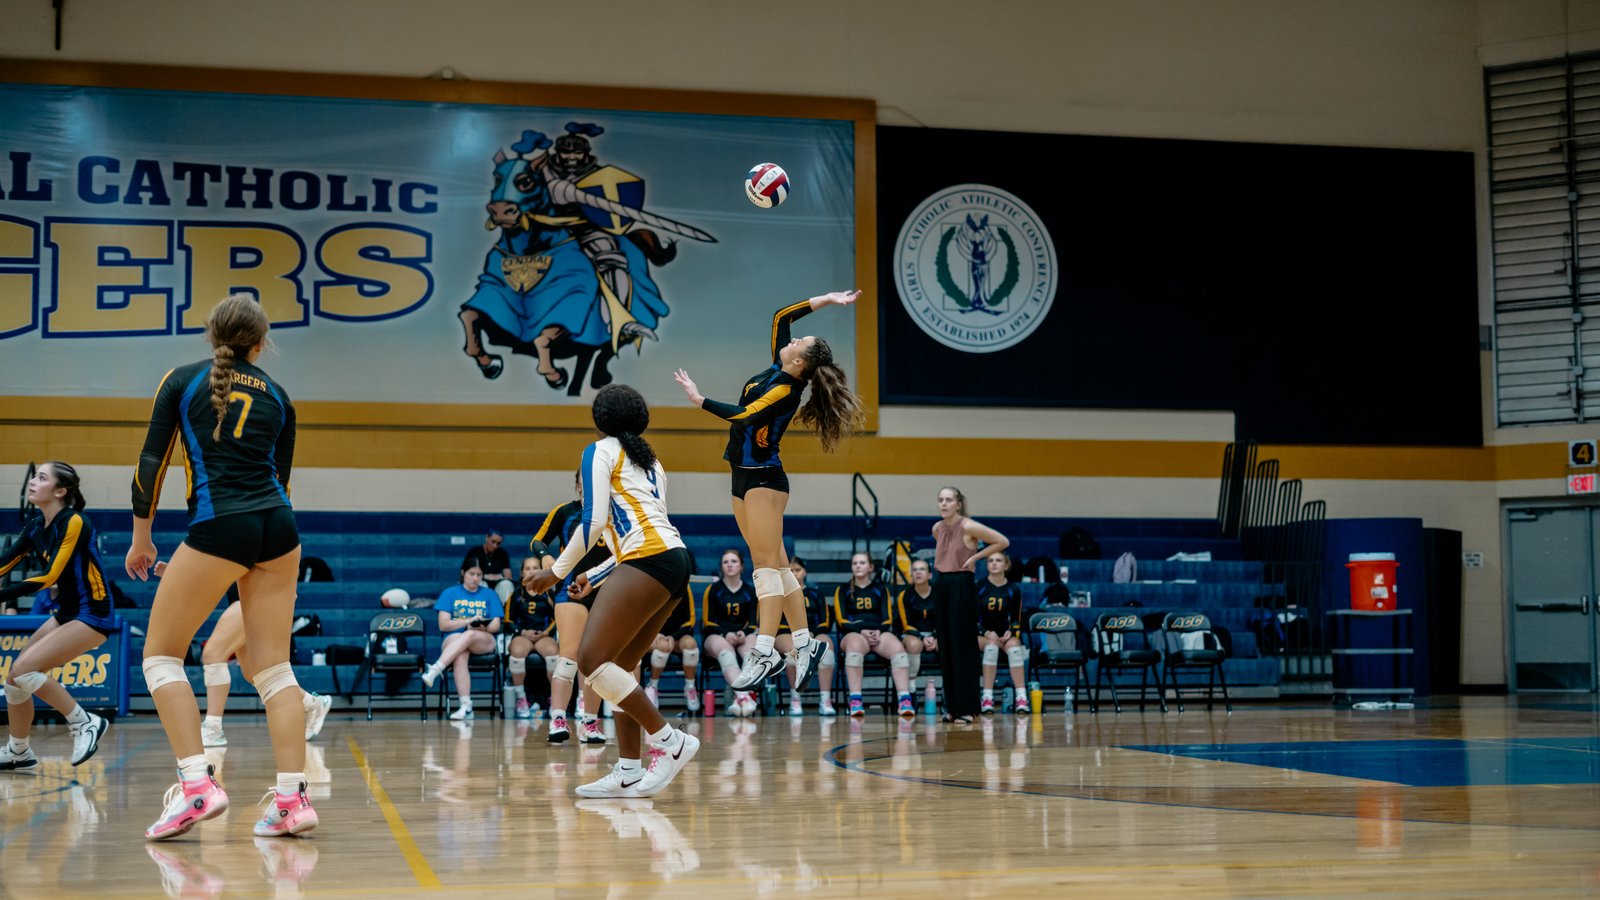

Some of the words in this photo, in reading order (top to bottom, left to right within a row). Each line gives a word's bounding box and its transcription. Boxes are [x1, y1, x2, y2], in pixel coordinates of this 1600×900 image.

[0, 151, 53, 201] L
[77, 155, 439, 213] CATHOLIC
[908, 200, 952, 251] CATHOLIC
[961, 194, 1021, 218] ATHLETIC
[1021, 221, 1047, 306] CONFERENCE
[923, 306, 1007, 342] ESTABLISHED
[1009, 312, 1031, 332] 1974
[228, 391, 254, 439] 7
[1576, 444, 1591, 463] 4
[1573, 475, 1594, 492] EXIT
[527, 601, 537, 615] 2
[726, 602, 740, 616] 13
[856, 597, 872, 610] 28
[987, 597, 1003, 611] 21
[378, 615, 417, 630] ACC
[1036, 615, 1070, 629] ACC
[1105, 615, 1137, 629] ACC
[1171, 614, 1204, 629] ACC
